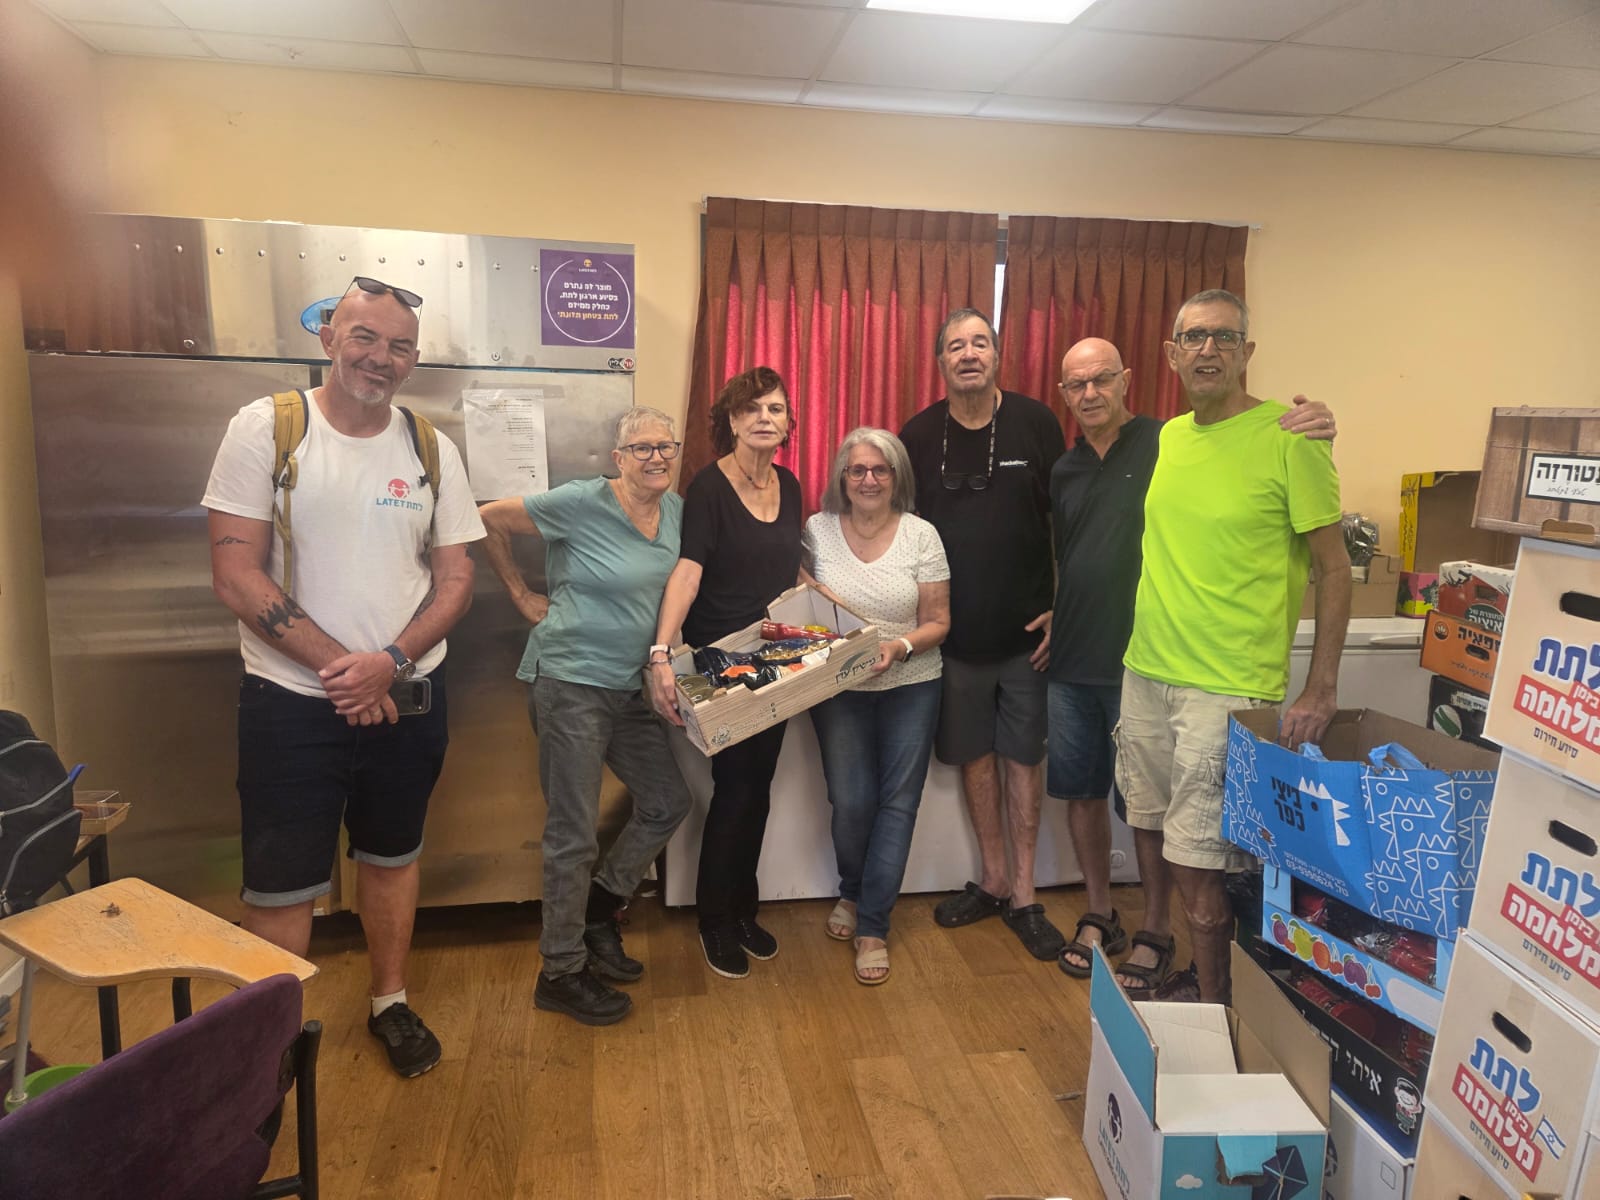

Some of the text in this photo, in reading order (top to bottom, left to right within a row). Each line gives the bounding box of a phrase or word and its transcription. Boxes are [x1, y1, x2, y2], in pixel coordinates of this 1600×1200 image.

[376, 498, 406, 509] LATET
[1534, 638, 1600, 690] לתת
[1520, 683, 1600, 746] מלחמה
[1558, 739, 1579, 758] סיוע
[1521, 852, 1600, 918] לתת
[1508, 893, 1600, 978] מלחמה
[1565, 909, 1595, 939] בזמן
[1345, 1049, 1381, 1096] איתי
[1470, 1038, 1540, 1112] לתת
[1458, 1072, 1535, 1171] מלחמה
[1504, 1101, 1529, 1134] בזמן
